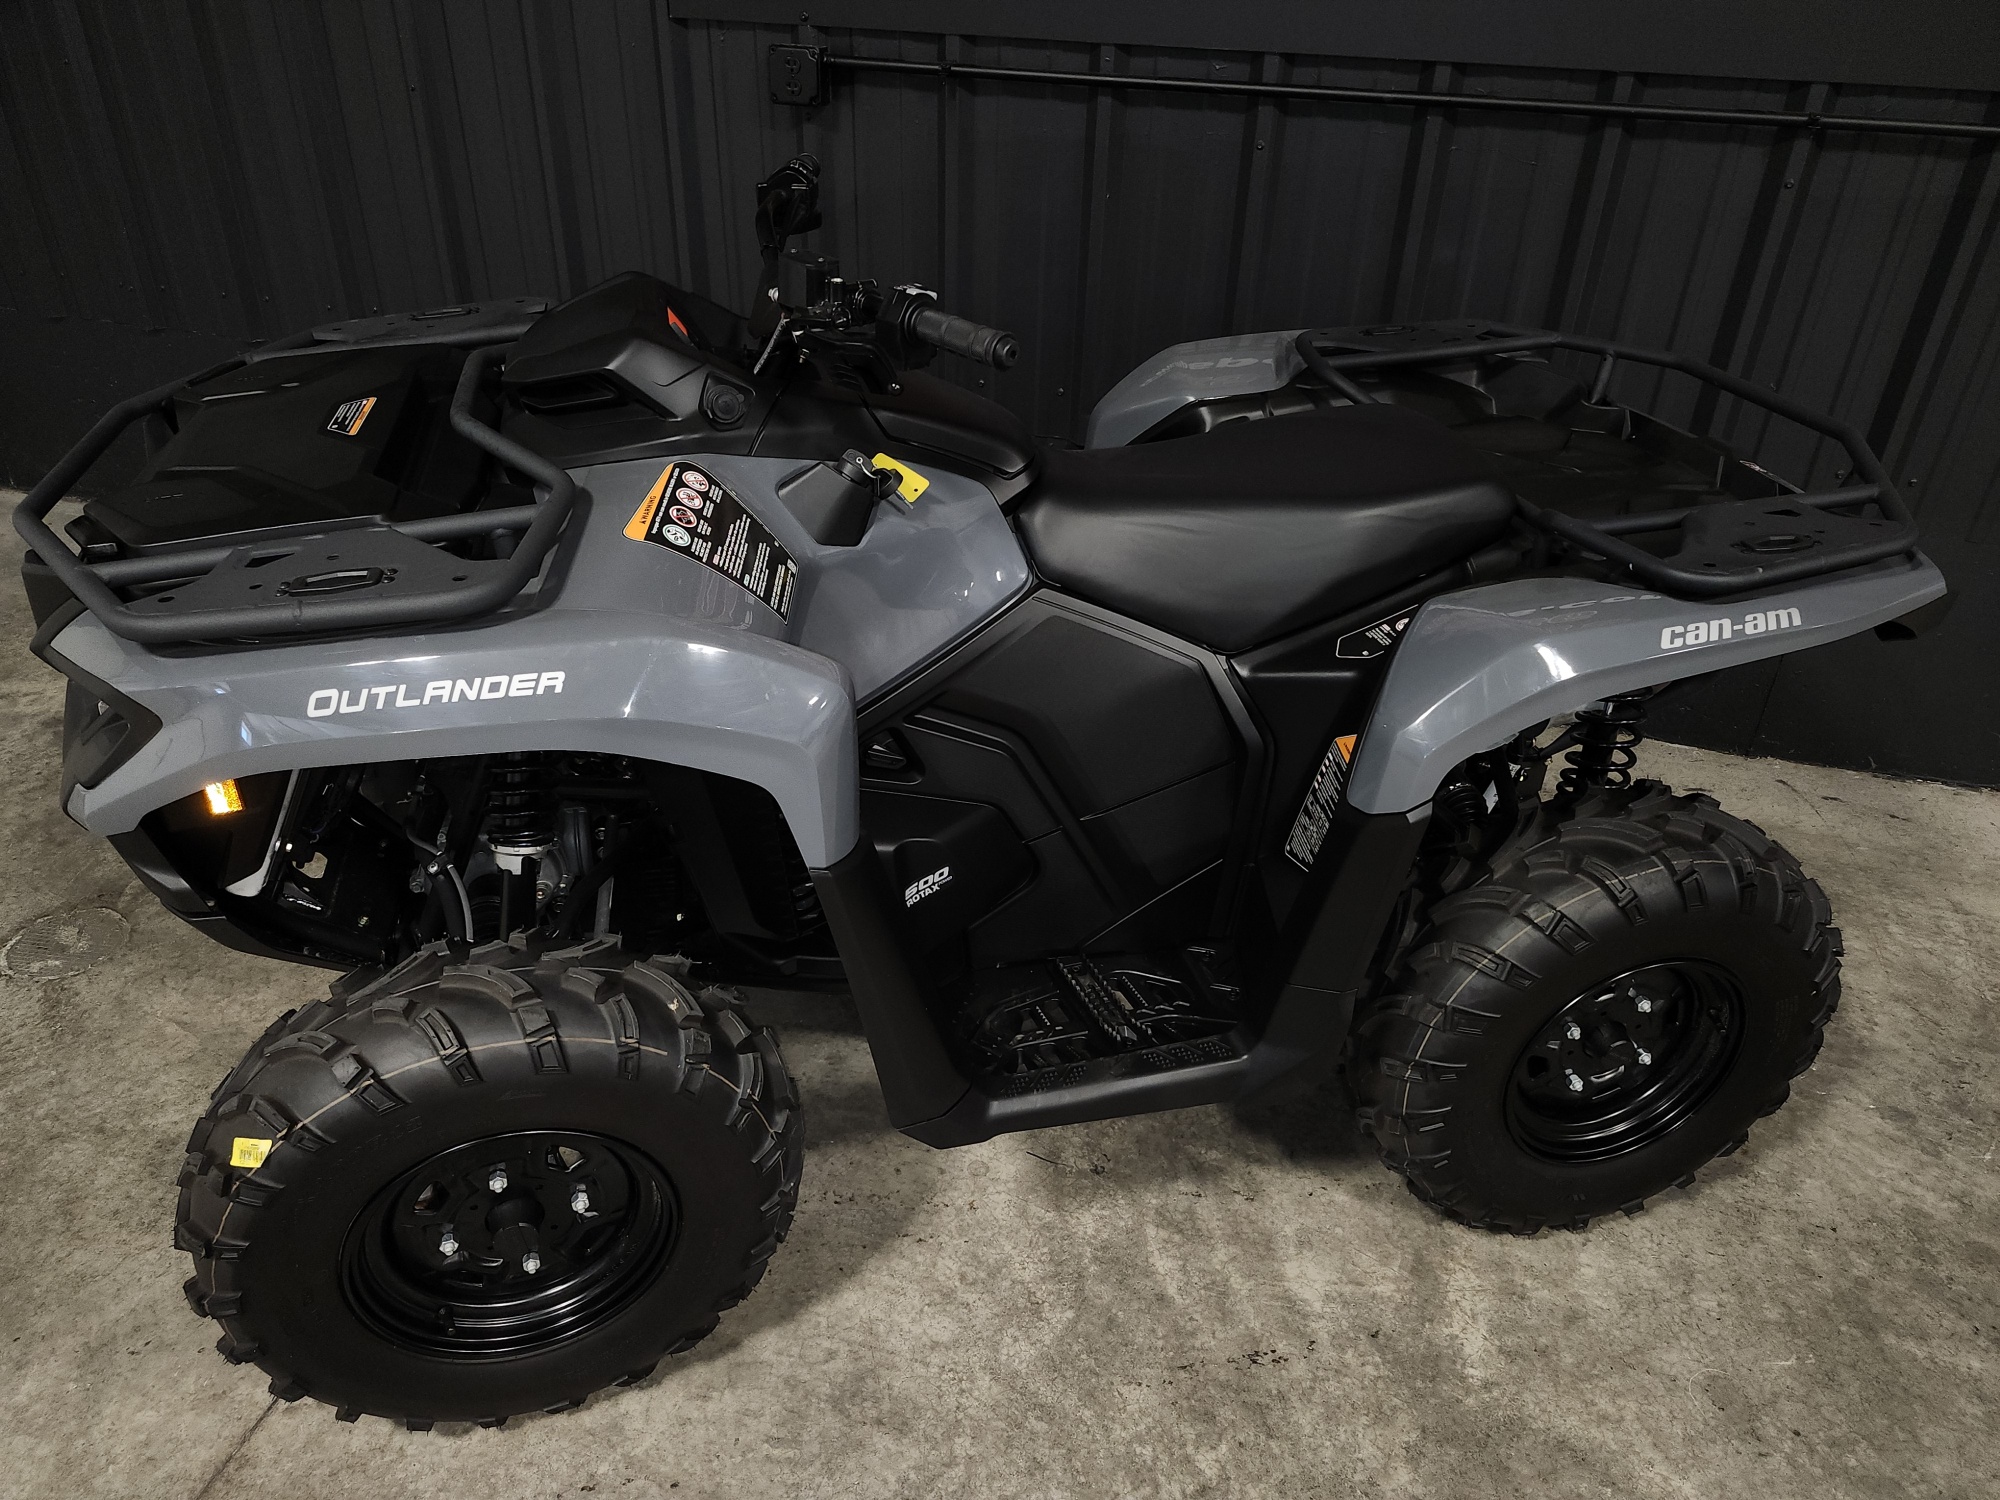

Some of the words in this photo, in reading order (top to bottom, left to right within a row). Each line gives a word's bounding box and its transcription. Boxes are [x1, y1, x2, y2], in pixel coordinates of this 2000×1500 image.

[641, 495, 656, 520] WARNING
[1660, 607, 1802, 650] can-am
[306, 670, 566, 718] OUTLANDER
[905, 866, 950, 901] 500
[906, 883, 940, 908] ROTAX
